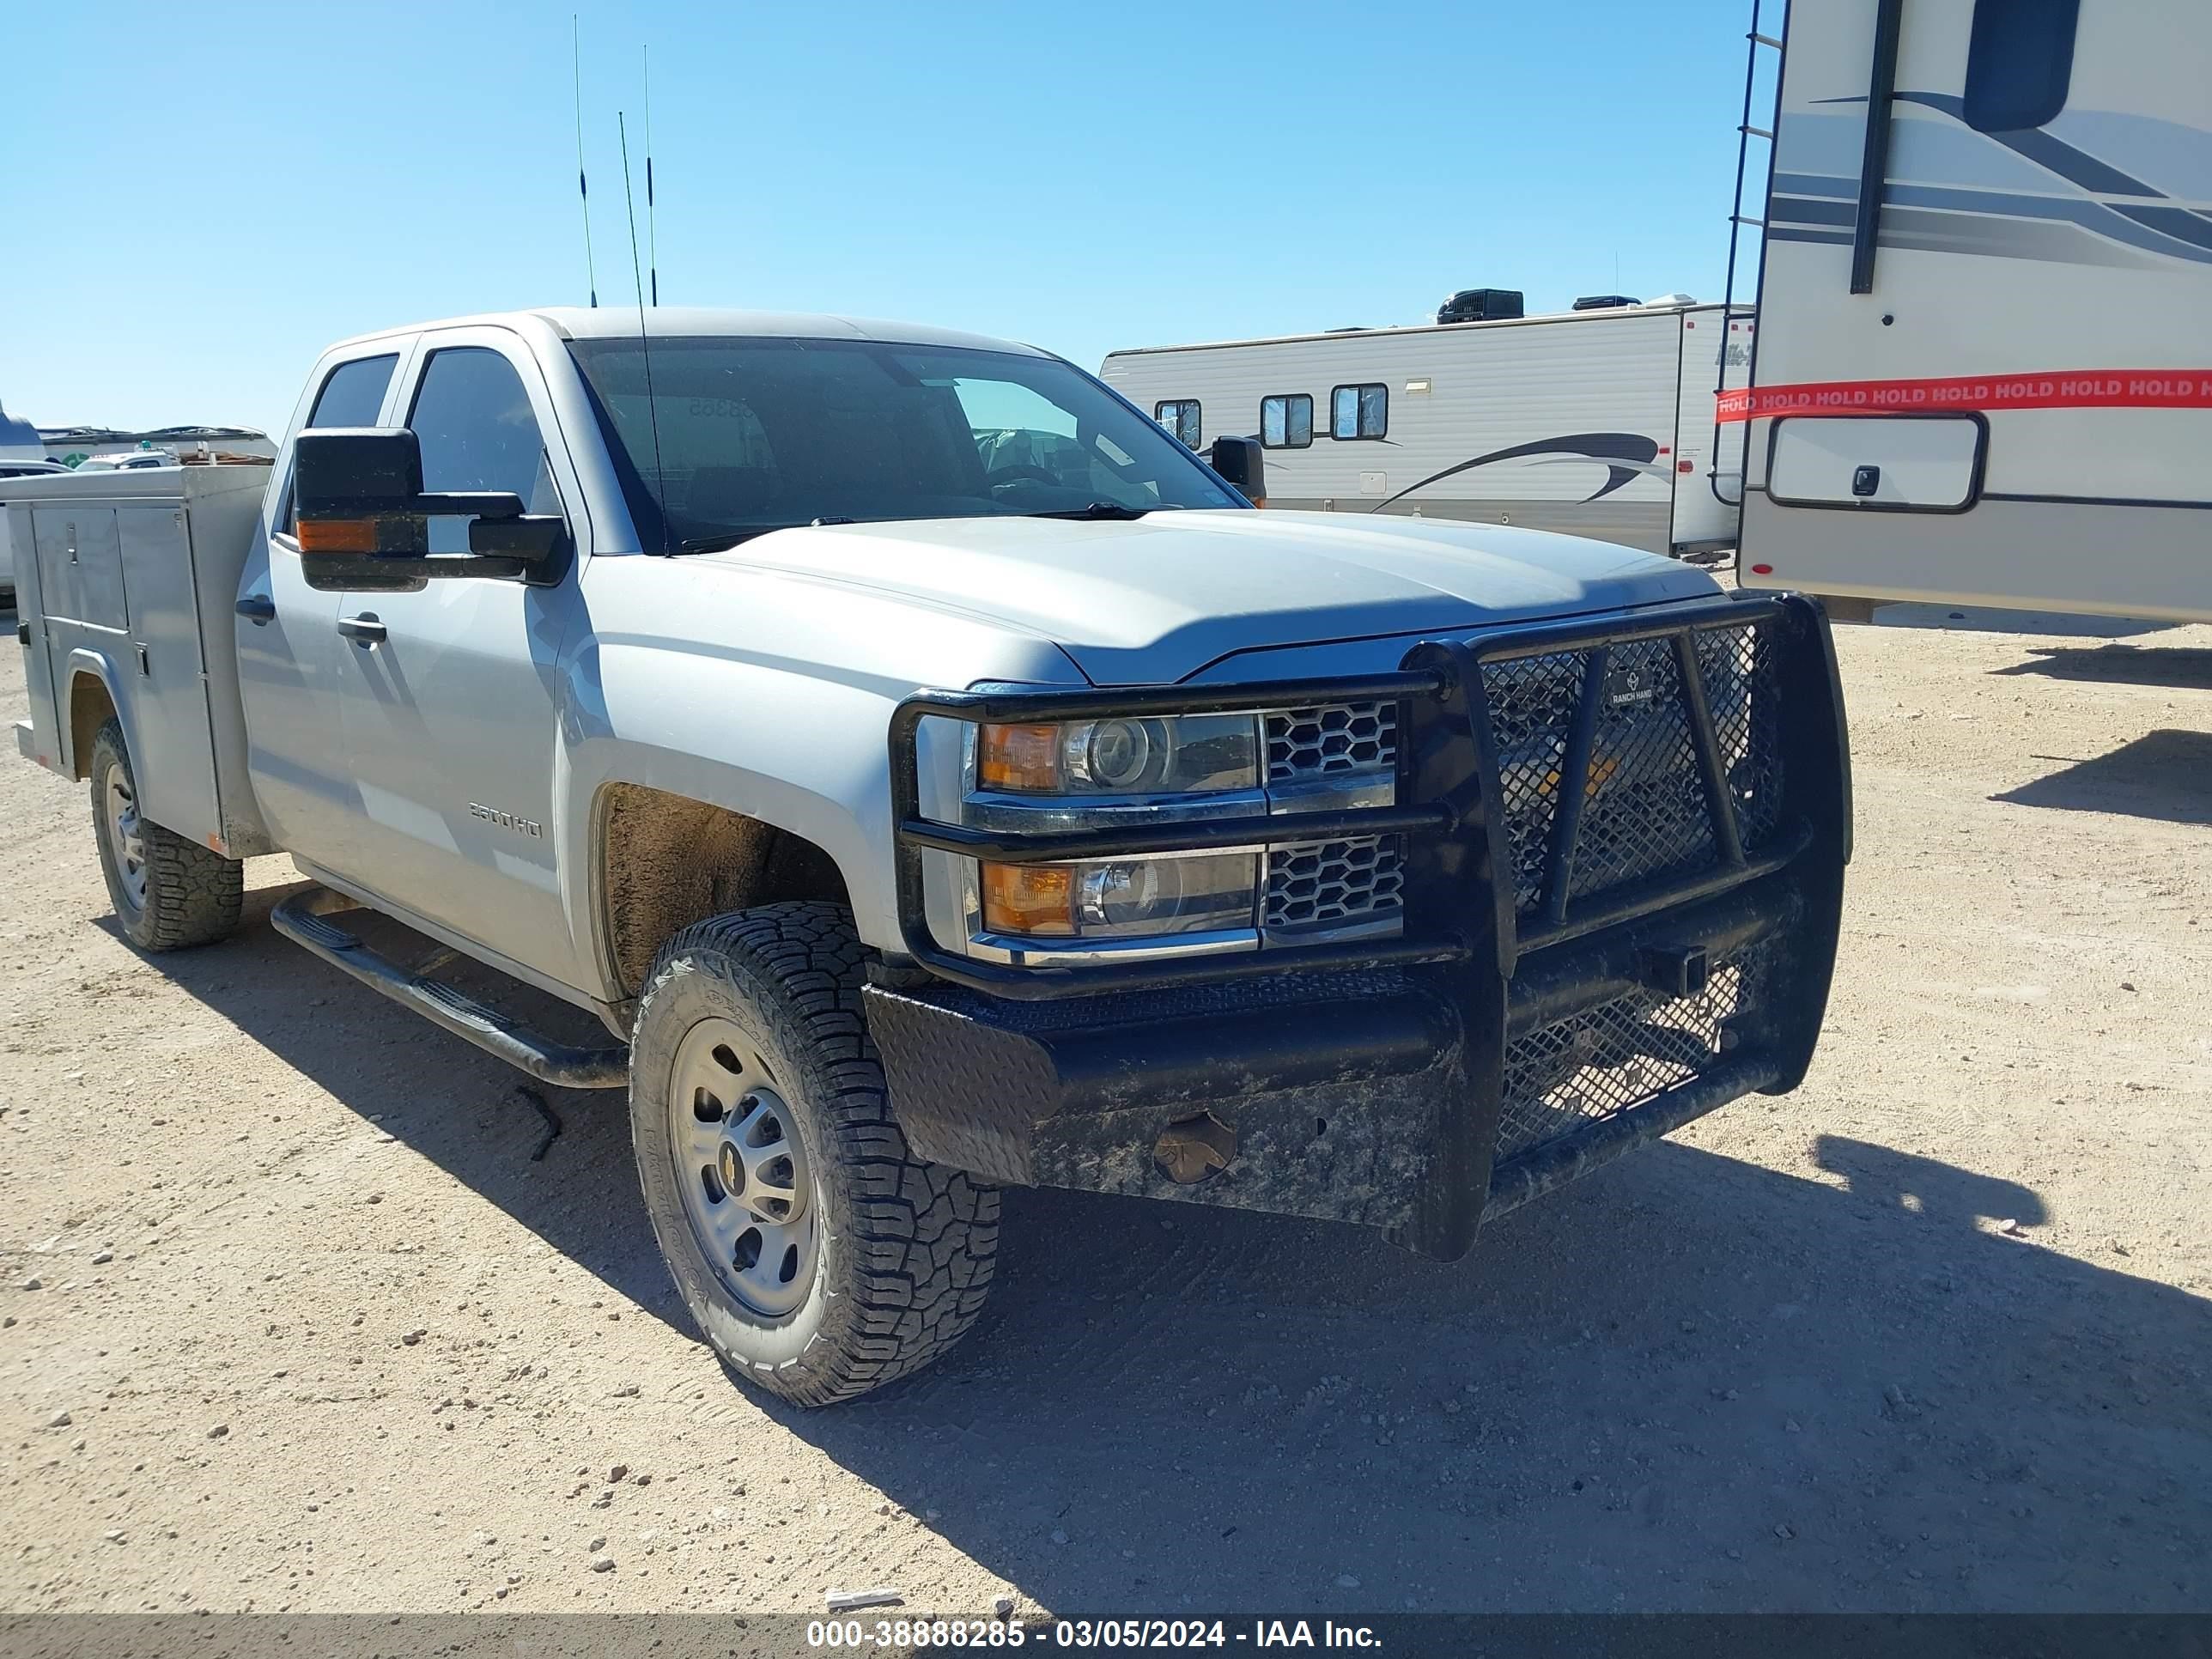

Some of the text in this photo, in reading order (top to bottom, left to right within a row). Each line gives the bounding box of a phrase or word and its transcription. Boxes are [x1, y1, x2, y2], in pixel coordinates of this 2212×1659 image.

[1718, 397, 1757, 413] HOLD
[1762, 392, 1811, 408] HOLD
[1815, 390, 1867, 406] HOLD
[1872, 388, 1926, 404] HOLD
[1932, 386, 1989, 403] HOLD
[1995, 382, 2054, 399] HOLD
[2060, 380, 2123, 397] HOLD
[2129, 380, 2194, 397] HOLD
[1613, 689, 1652, 704] RANCH HAND
